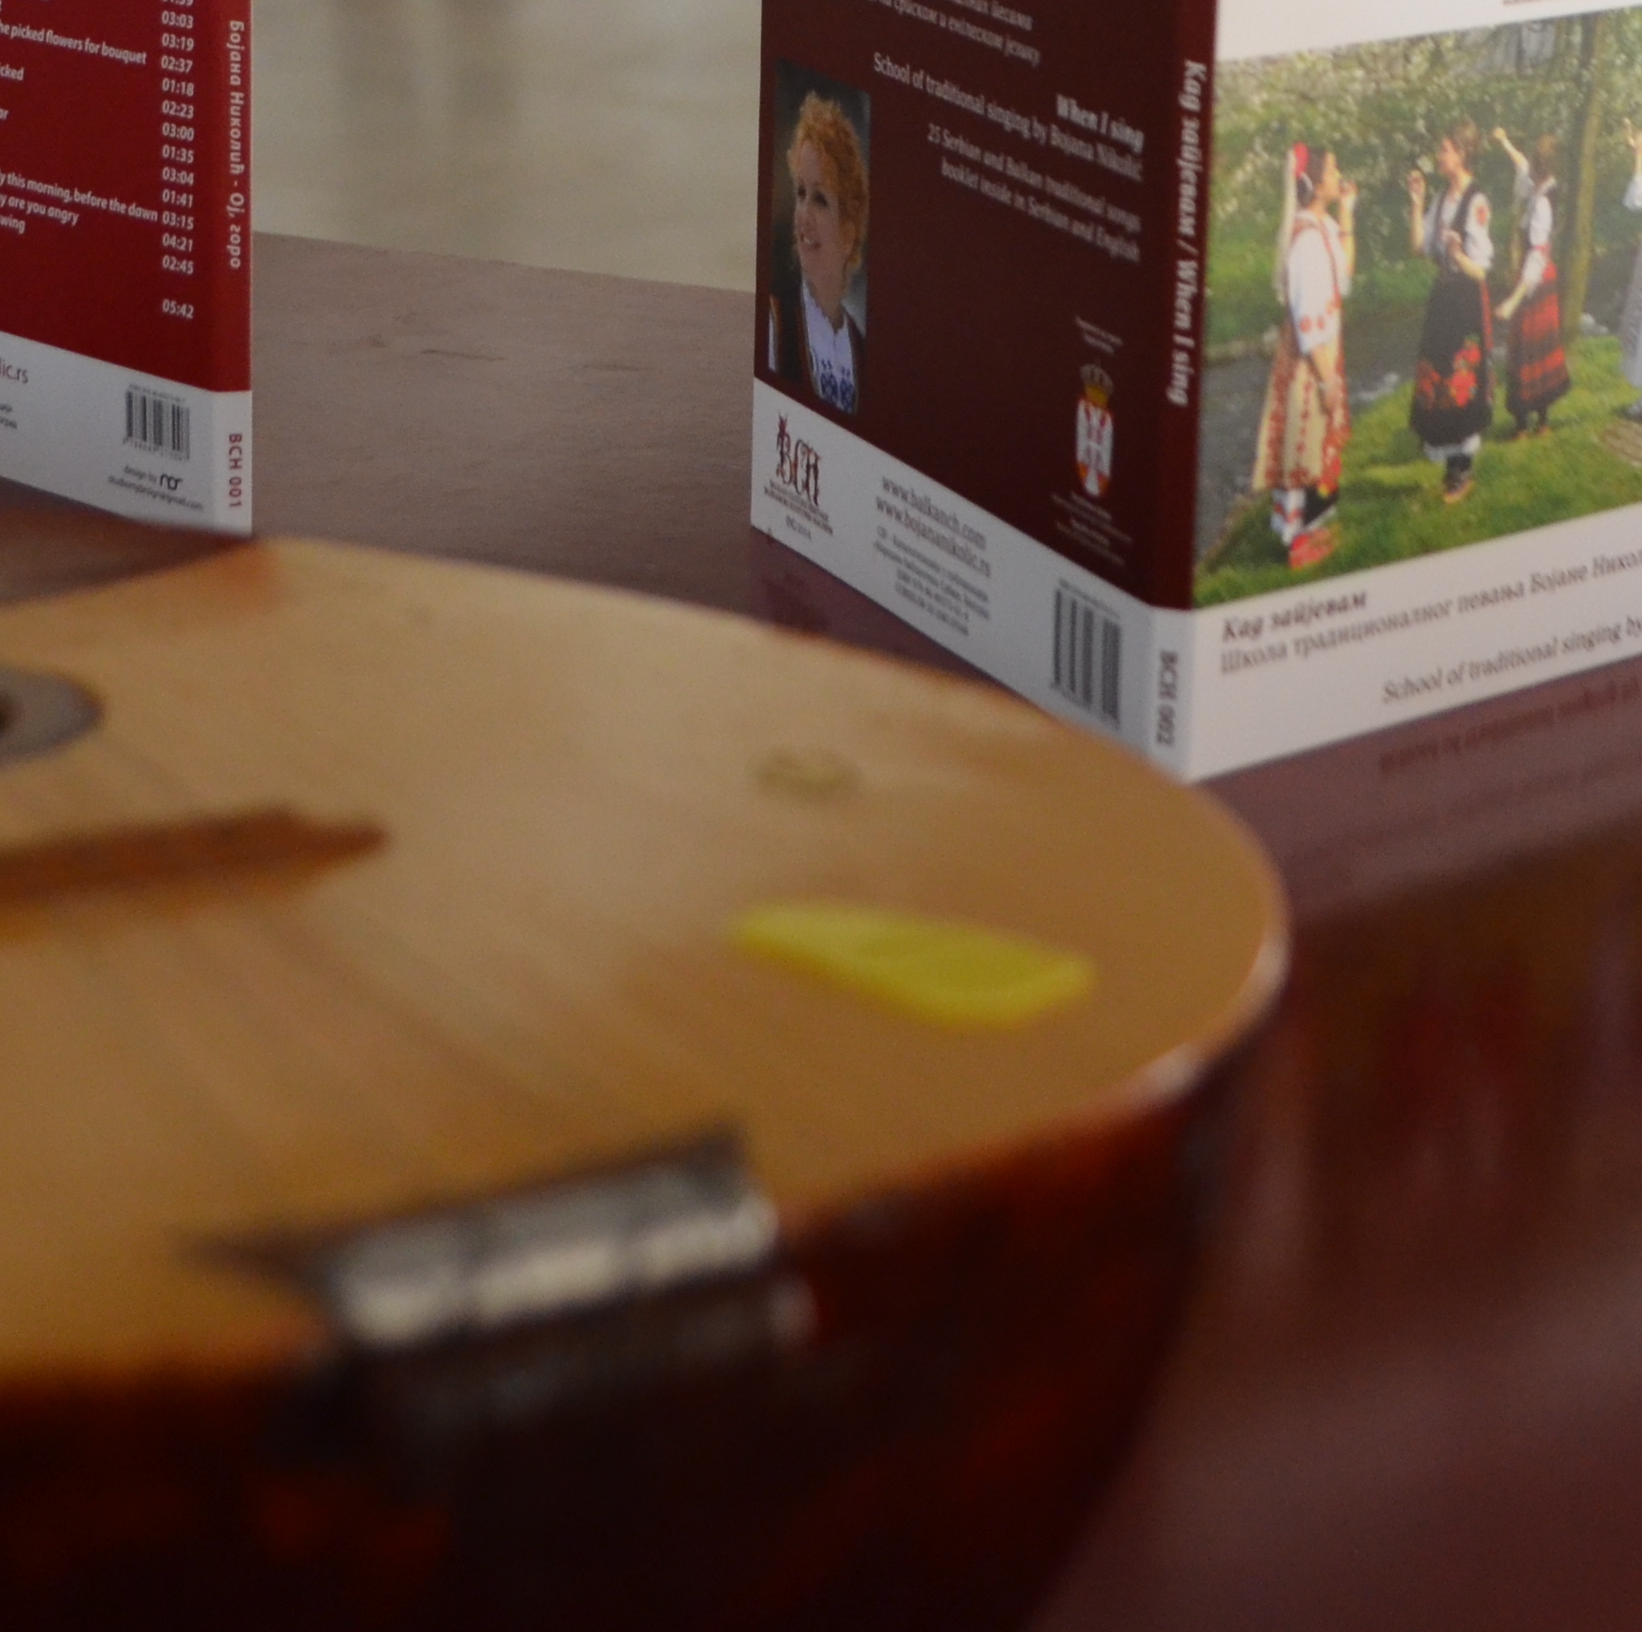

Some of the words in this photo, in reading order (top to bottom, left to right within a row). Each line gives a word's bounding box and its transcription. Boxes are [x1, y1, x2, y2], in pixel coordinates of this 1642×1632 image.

[160, 9, 194, 30] 03:03
[10, 23, 46, 43] picked
[45, 28, 84, 51] flowers
[83, 37, 101, 54] for
[100, 41, 147, 65] bouquet
[161, 32, 195, 52] 03:19
[226, 20, 245, 86] Бојана
[160, 54, 194, 74] 02:37
[161, 77, 195, 97] 01:18
[1177, 59, 1206, 112] Кад
[161, 99, 195, 120] 02:23
[873, 51, 911, 85] School
[911, 69, 925, 90] of
[925, 74, 985, 116] traditional
[986, 102, 1031, 140] singing
[1031, 116, 1048, 145] by
[1049, 123, 1095, 162] Bojana
[161, 121, 195, 142] 03:00
[229, 91, 245, 175] Николић
[1056, 94, 1099, 131] When
[1109, 120, 1145, 154] sing
[161, 143, 194, 164] 01:35
[161, 166, 195, 186] 03:04
[6, 171, 26, 189] this
[26, 179, 74, 204] morning,
[73, 187, 108, 210] before
[108, 197, 128, 215] the
[127, 202, 159, 222] dawn
[7, 196, 26, 210] are
[26, 200, 47, 216] you
[47, 206, 80, 227] angry
[161, 188, 194, 208] 01:41
[161, 210, 195, 231] 03:15
[161, 232, 194, 252] 04:21
[161, 254, 194, 275] 02:45
[161, 298, 195, 320] 05:42
[1174, 260, 1199, 330] When
[1165, 349, 1194, 407] sing
[228, 433, 243, 470] BCH
[228, 476, 243, 507] 001
[1158, 650, 1179, 701] BCH
[1382, 668, 1443, 705] School
[1445, 661, 1466, 687] of
[1467, 636, 1559, 682] traditional
[1561, 623, 1622, 655] singing
